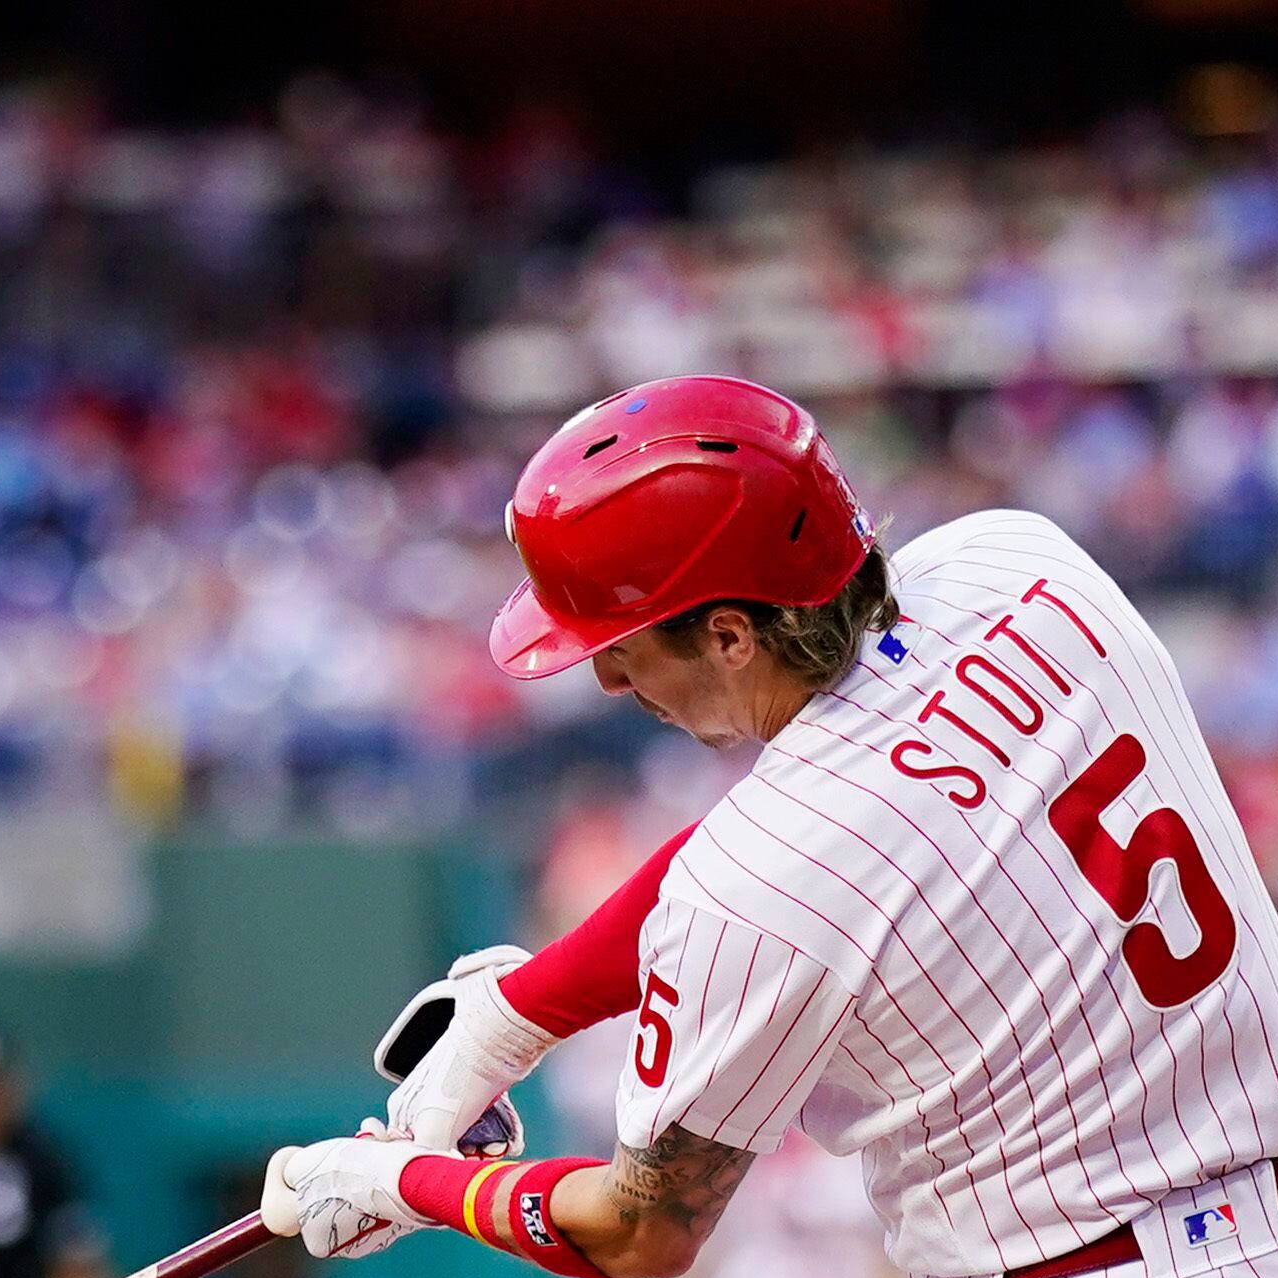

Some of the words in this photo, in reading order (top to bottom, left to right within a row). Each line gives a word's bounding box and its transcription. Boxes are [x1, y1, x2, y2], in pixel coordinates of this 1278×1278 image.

[889, 578, 1108, 810] STOTT
[1047, 733, 1237, 1009] 5
[634, 971, 679, 1088] 5
[621, 1161, 690, 1191] VEGAS
